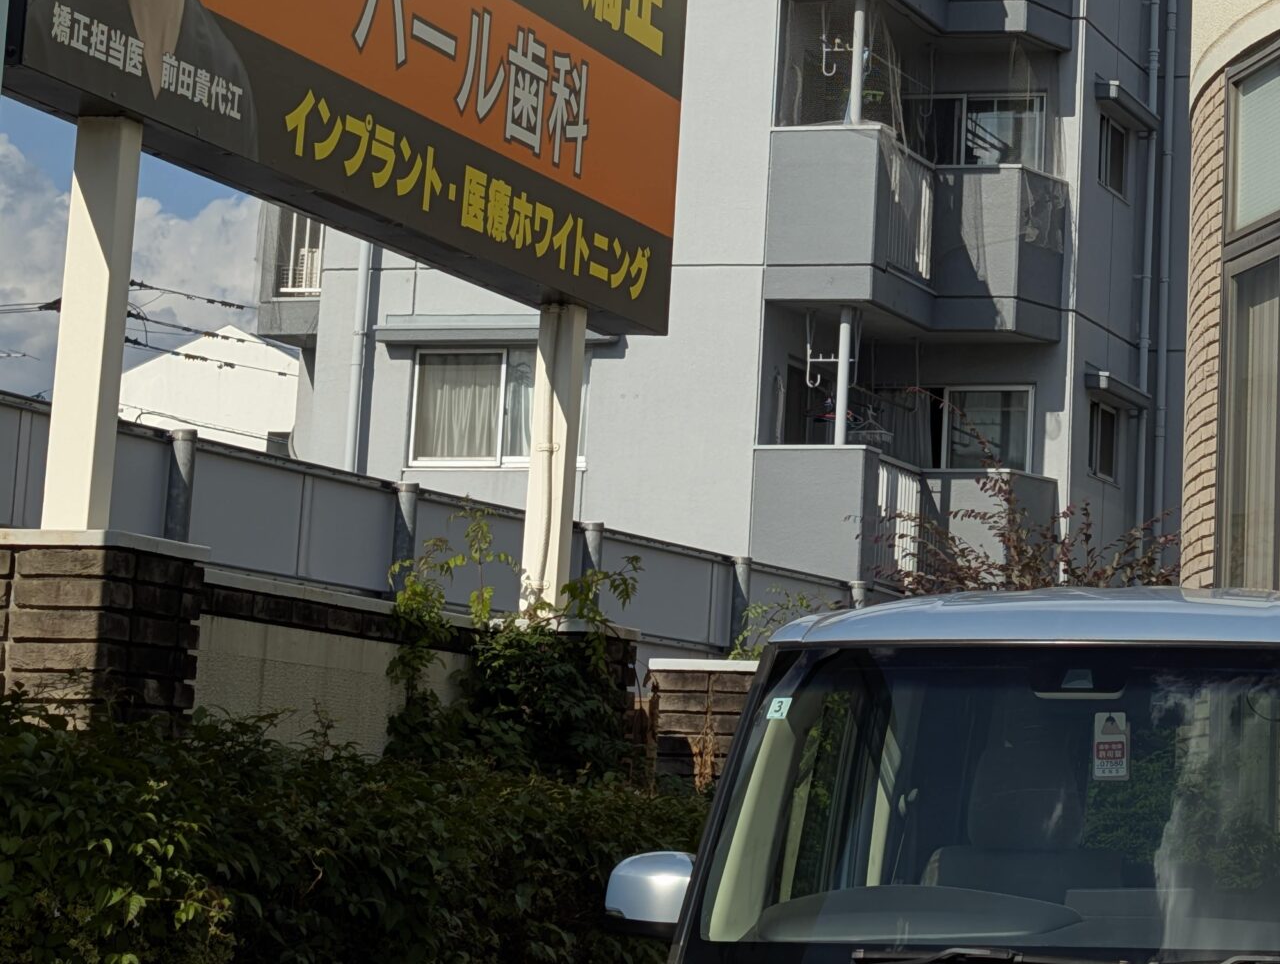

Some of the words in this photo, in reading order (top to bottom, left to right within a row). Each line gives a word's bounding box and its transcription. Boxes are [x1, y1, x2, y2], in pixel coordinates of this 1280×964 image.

[51, 1, 144, 77] 矯正担当医
[160, 52, 243, 121] 前田貴代江
[285, 88, 650, 300] インプラント・医療ホワイトニング
